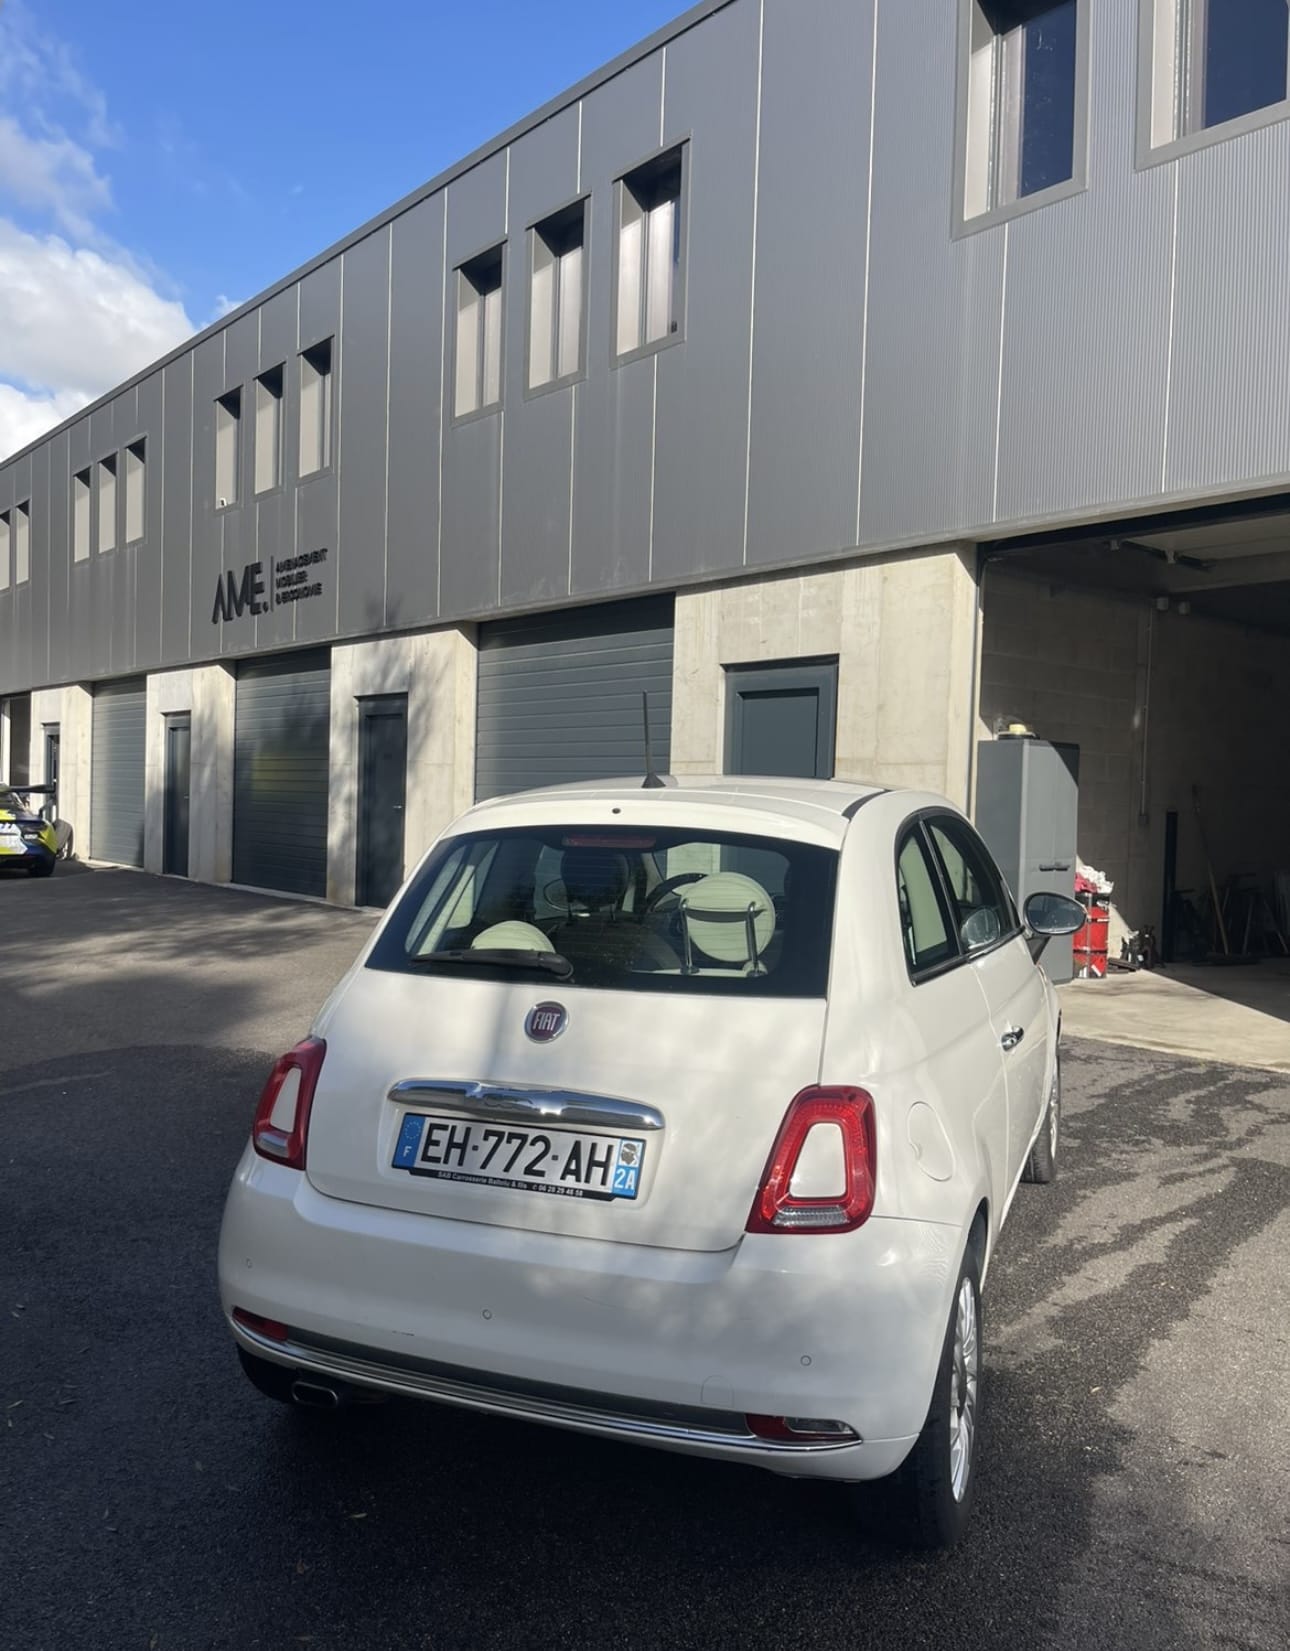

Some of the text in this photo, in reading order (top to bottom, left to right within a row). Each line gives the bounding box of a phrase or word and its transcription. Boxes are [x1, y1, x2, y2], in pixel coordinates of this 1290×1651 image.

[532, 1011, 561, 1031] FIAT
[402, 1146, 412, 1157] F
[613, 1168, 636, 1190] 2A
